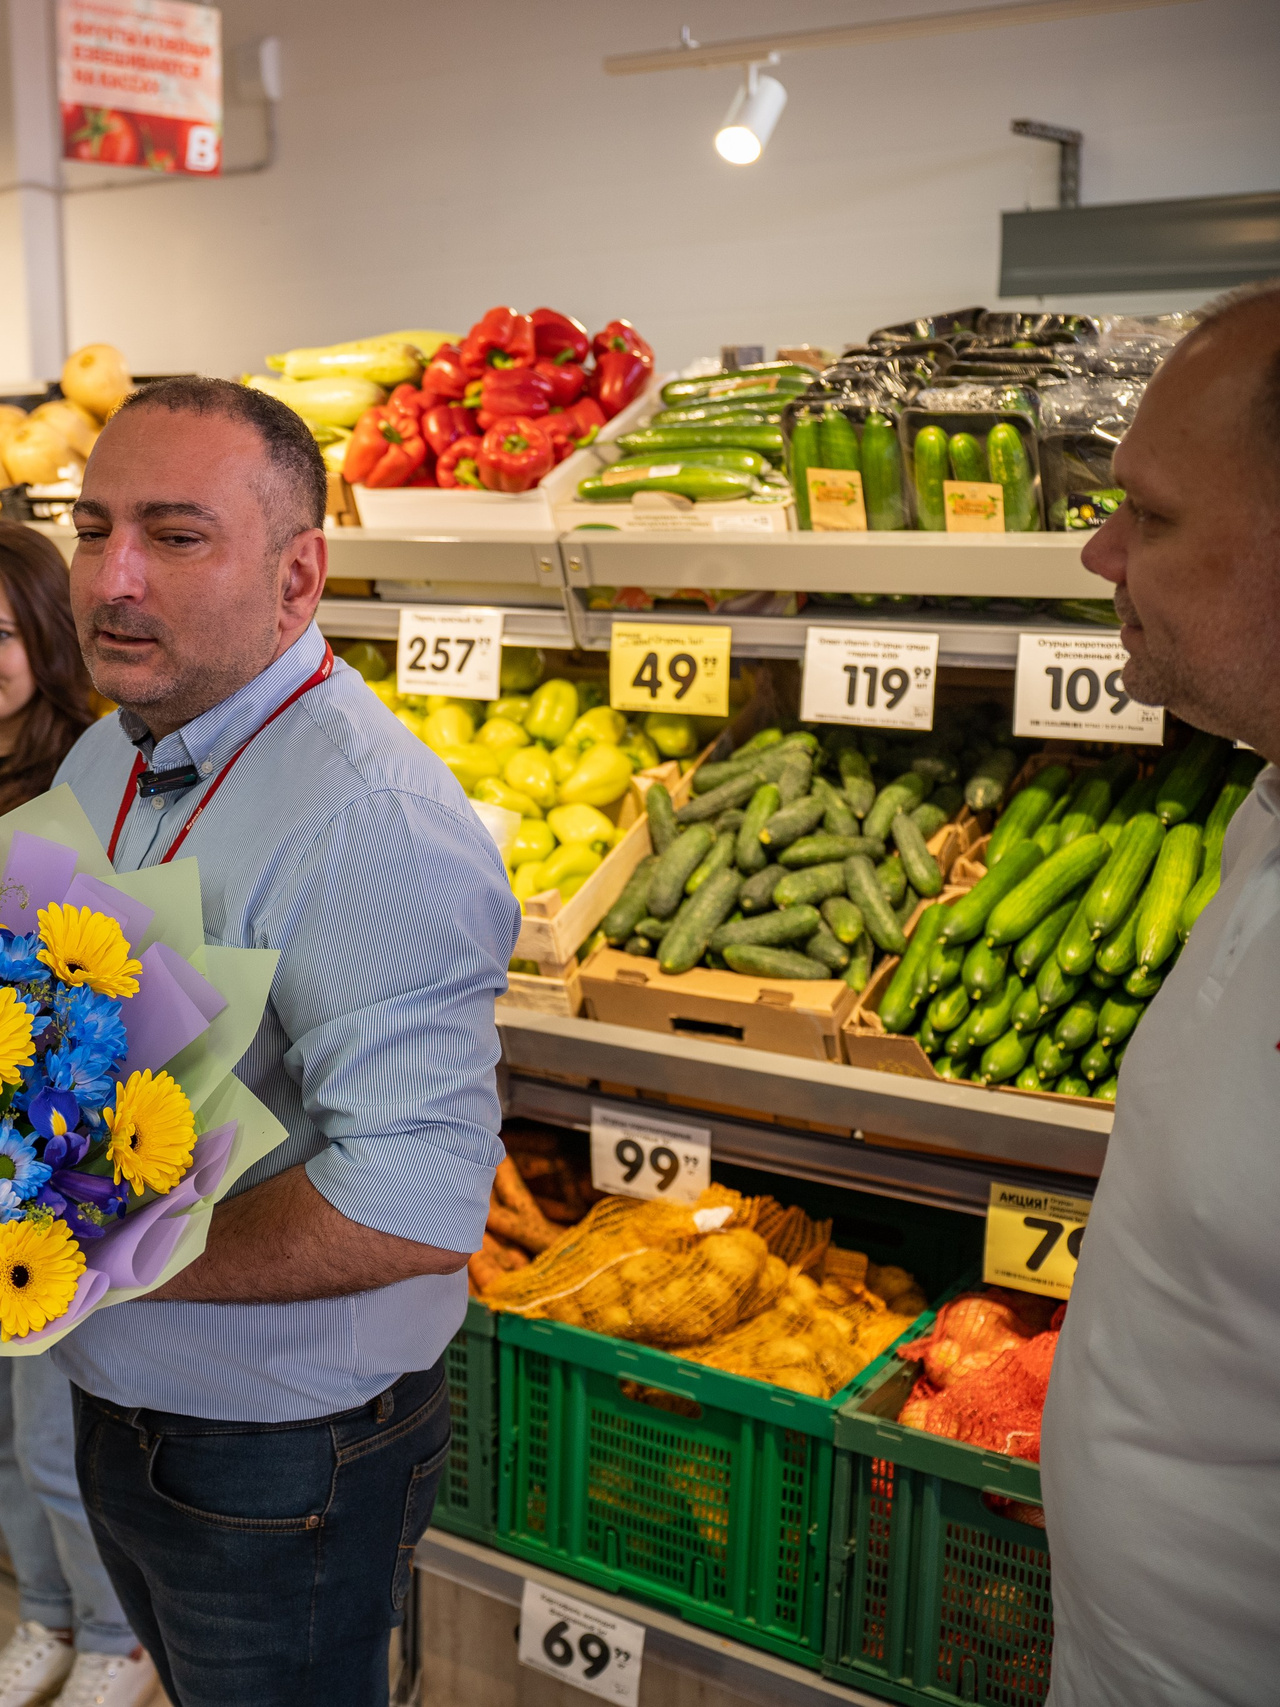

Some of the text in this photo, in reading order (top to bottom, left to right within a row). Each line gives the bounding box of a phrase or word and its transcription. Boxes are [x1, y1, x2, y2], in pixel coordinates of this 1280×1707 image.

[408, 636, 476, 673] 257
[1037, 638, 1072, 650] Огурцы
[632, 652, 698, 700] 49
[842, 665, 932, 710] 119 99
[1045, 667, 1131, 715] 109
[615, 1139, 680, 1193] 99
[1000, 1190, 1049, 1211] АКЦИЯ!
[543, 1621, 611, 1681] 69
